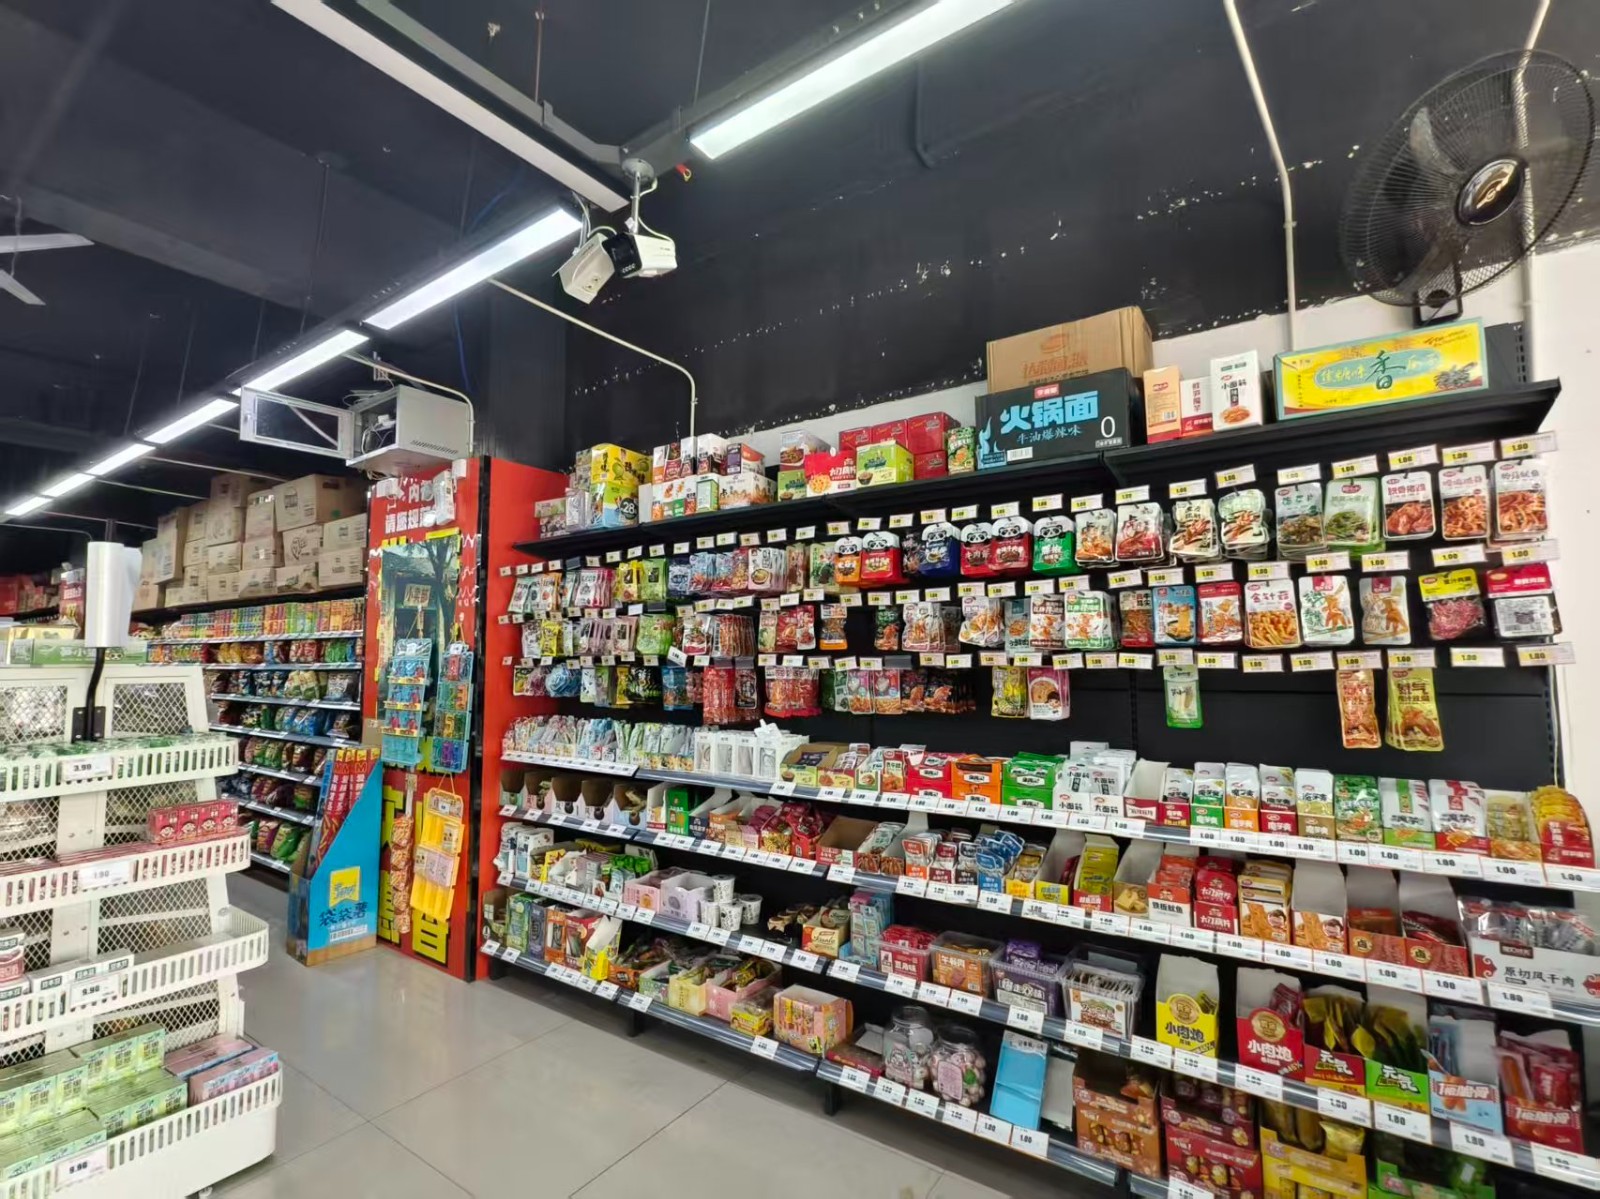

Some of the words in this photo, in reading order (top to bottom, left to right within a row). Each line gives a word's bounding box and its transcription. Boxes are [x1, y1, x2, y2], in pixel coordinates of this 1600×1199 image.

[1000, 390, 1098, 434] 火锅面
[1017, 424, 1081, 444] 牛油爆辣味
[1504, 967, 1574, 988] 原切风干肉
